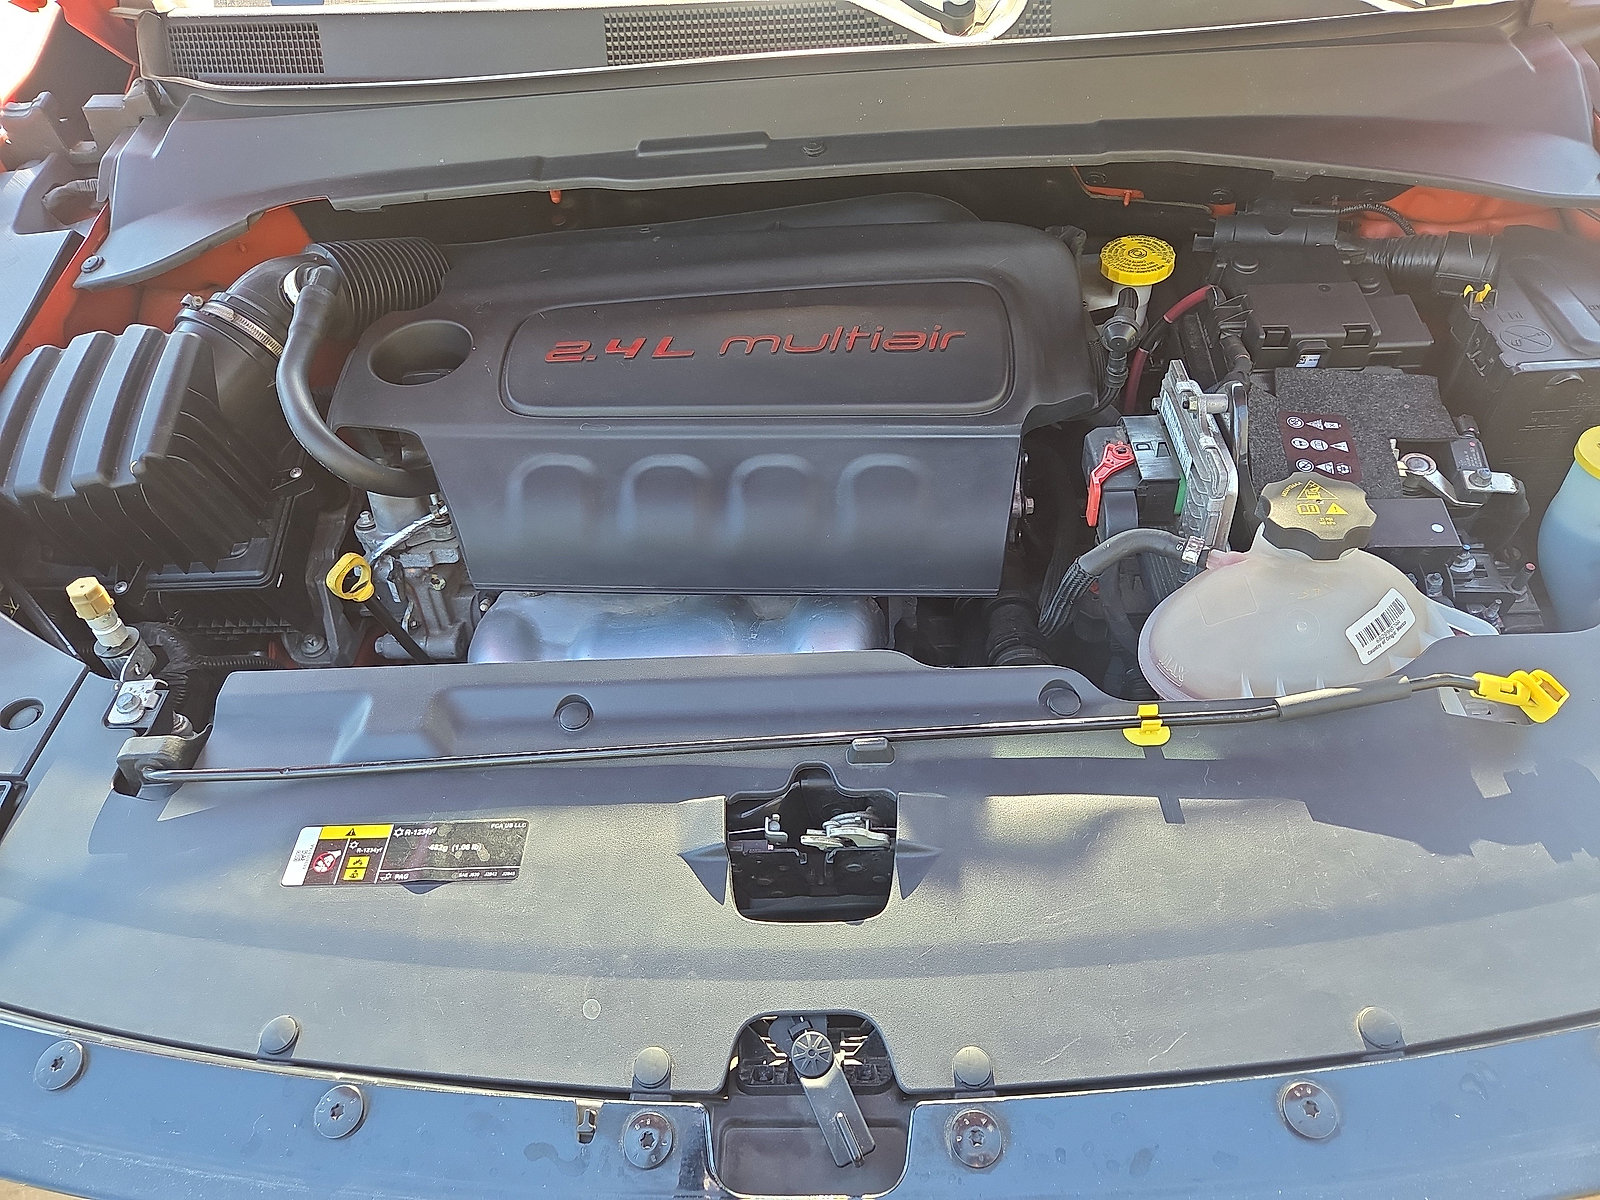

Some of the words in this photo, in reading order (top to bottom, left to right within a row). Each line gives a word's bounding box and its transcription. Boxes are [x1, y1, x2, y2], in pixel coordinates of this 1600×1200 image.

[544, 336, 695, 363] 2.4L
[719, 325, 967, 355] multiair
[1367, 643, 1383, 655] Country
[404, 827, 437, 836] R-1234yf
